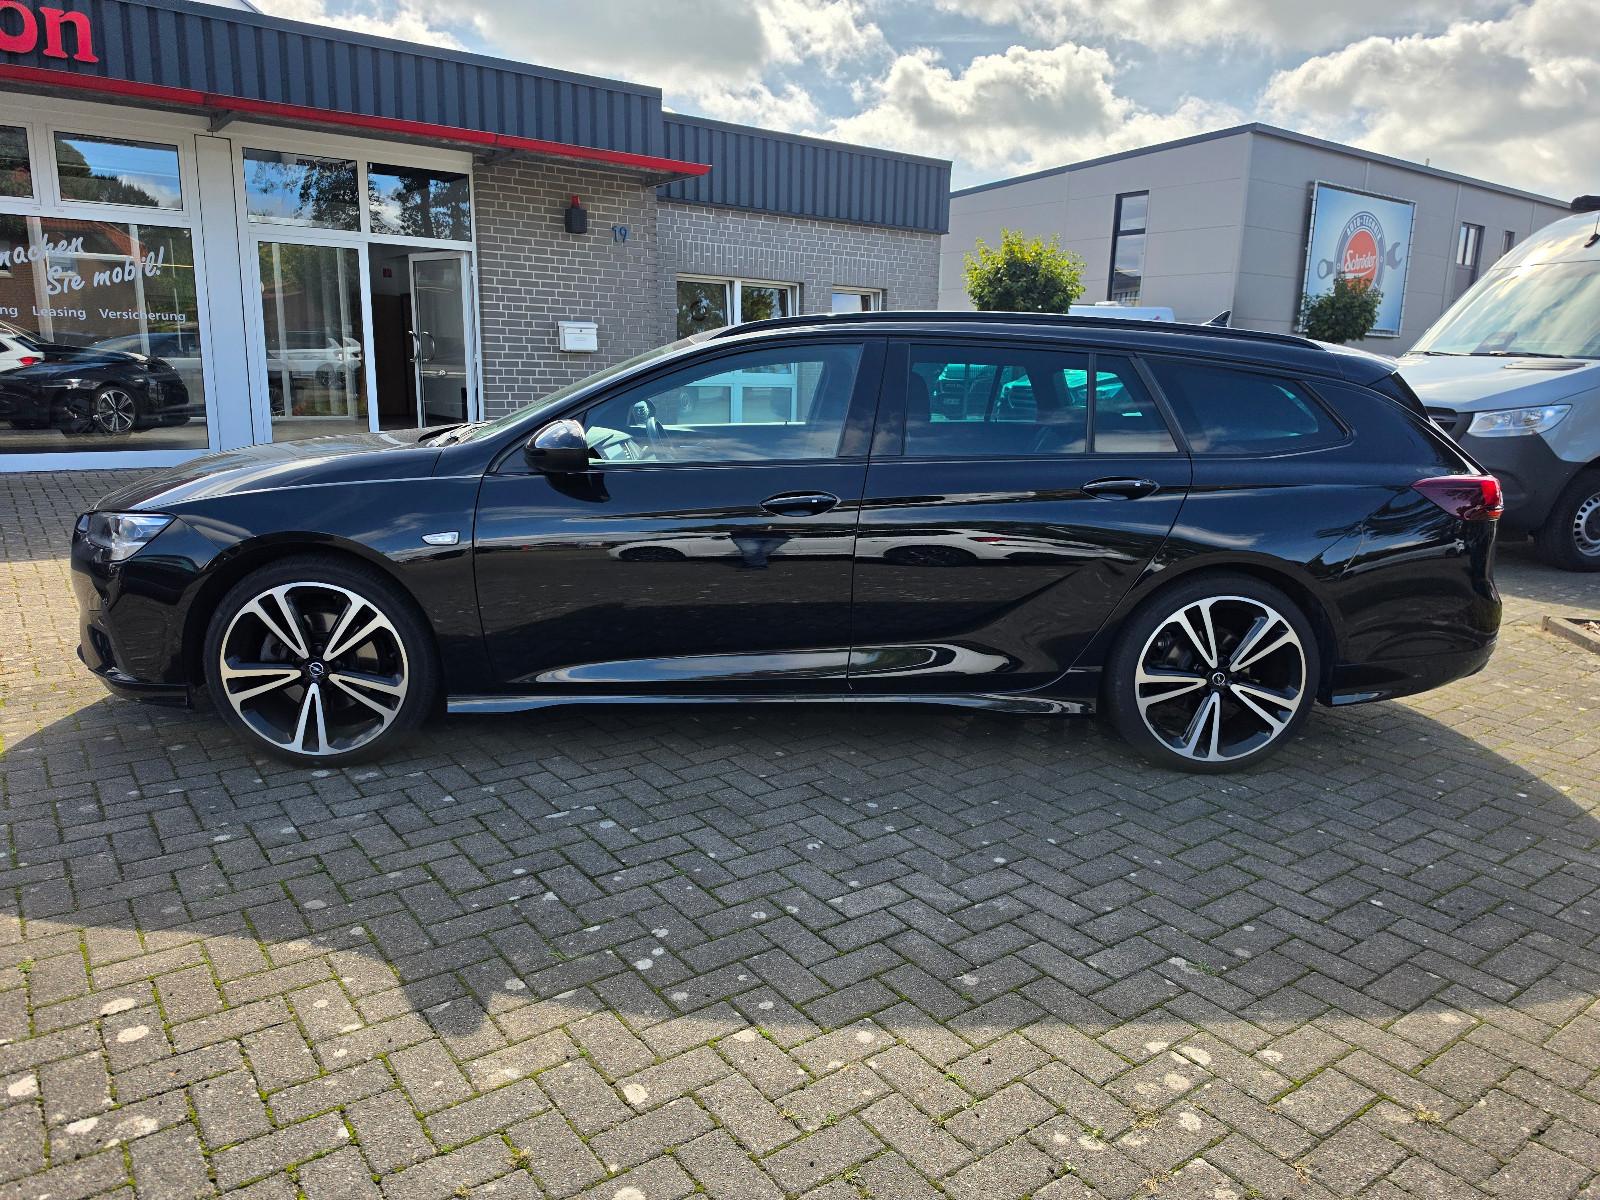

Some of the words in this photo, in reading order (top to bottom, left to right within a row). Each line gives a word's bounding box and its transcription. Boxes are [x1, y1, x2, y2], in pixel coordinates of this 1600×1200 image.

[0, 0, 99, 63] on
[612, 225, 627, 243] 19
[46, 265, 86, 295] Sie
[94, 246, 164, 288] mobil!
[32, 305, 87, 320] Leasing
[99, 308, 186, 322] Versicherung
